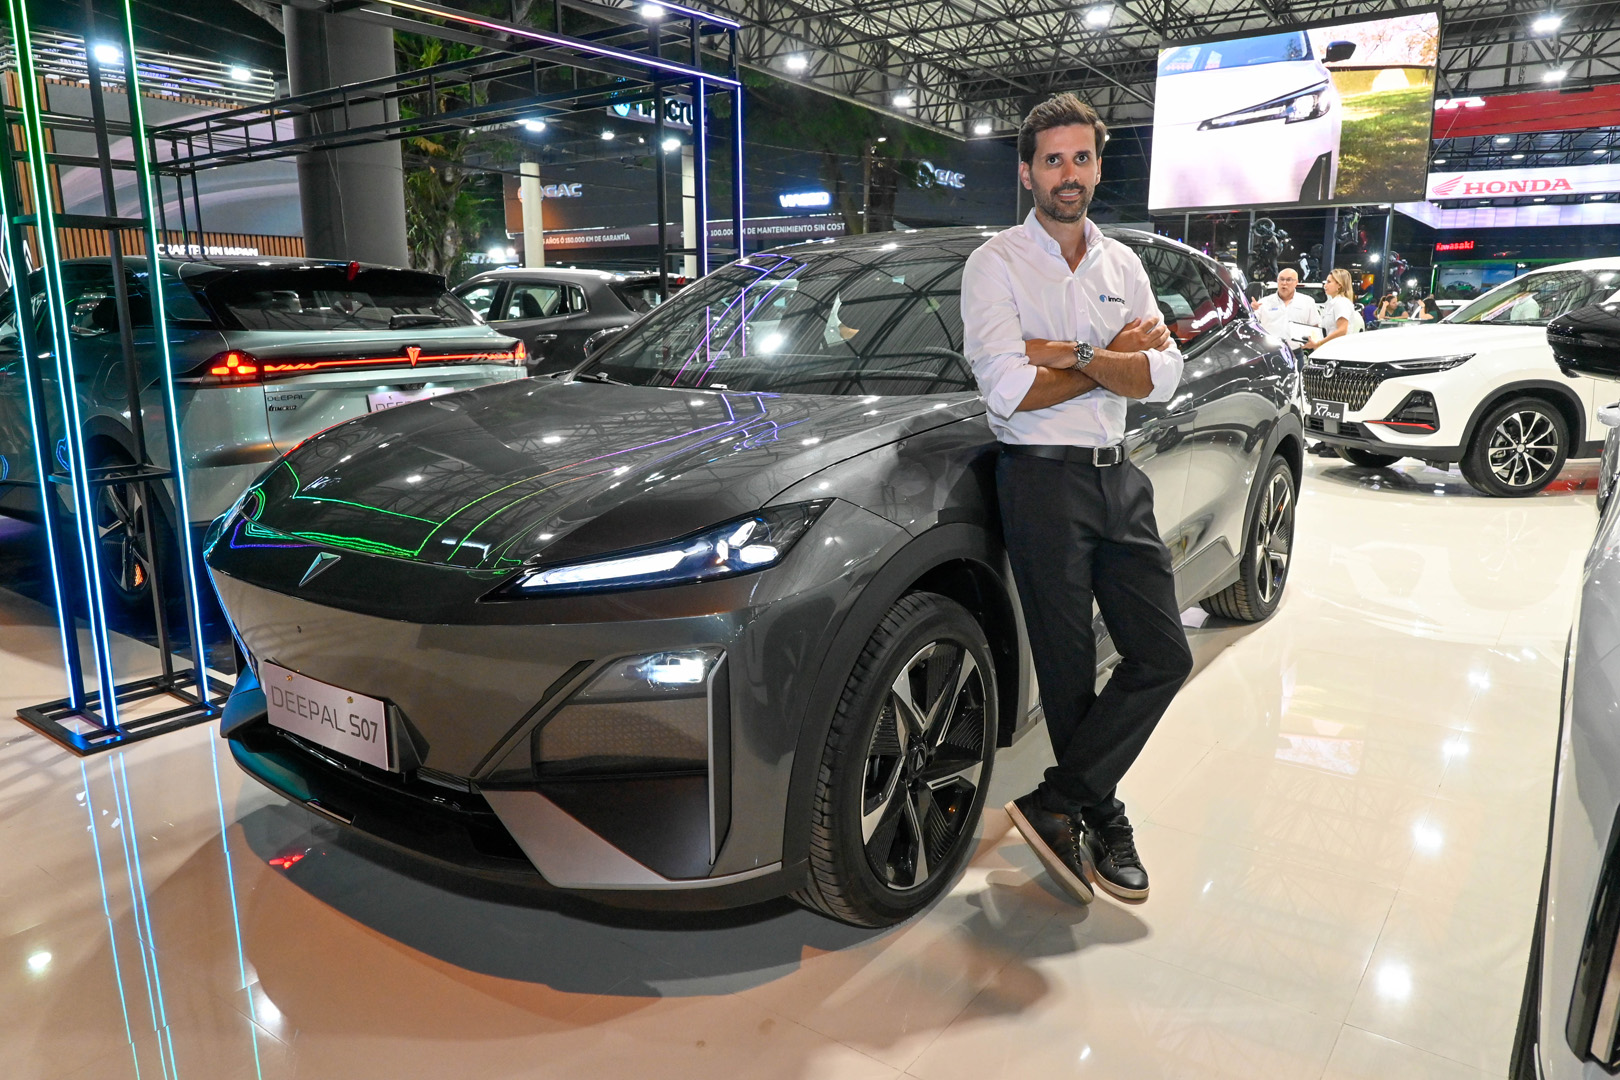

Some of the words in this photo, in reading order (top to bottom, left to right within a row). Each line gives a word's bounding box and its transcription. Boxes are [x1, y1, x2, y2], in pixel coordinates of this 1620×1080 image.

[935, 169, 965, 188] GAC
[543, 183, 582, 197] GAC
[1462, 178, 1573, 195] HONDA
[757, 226, 813, 235] MANTENIMIENTO
[827, 223, 846, 231] COST
[546, 235, 560, 245] AÑOS
[595, 234, 602, 242] DE
[602, 232, 630, 241] GARANTÍA
[209, 246, 223, 255] IN
[224, 247, 259, 256] JAPAN
[1436, 241, 1474, 251] Kawasaki
[271, 685, 347, 733] DEEPAL
[349, 713, 379, 743] S07
